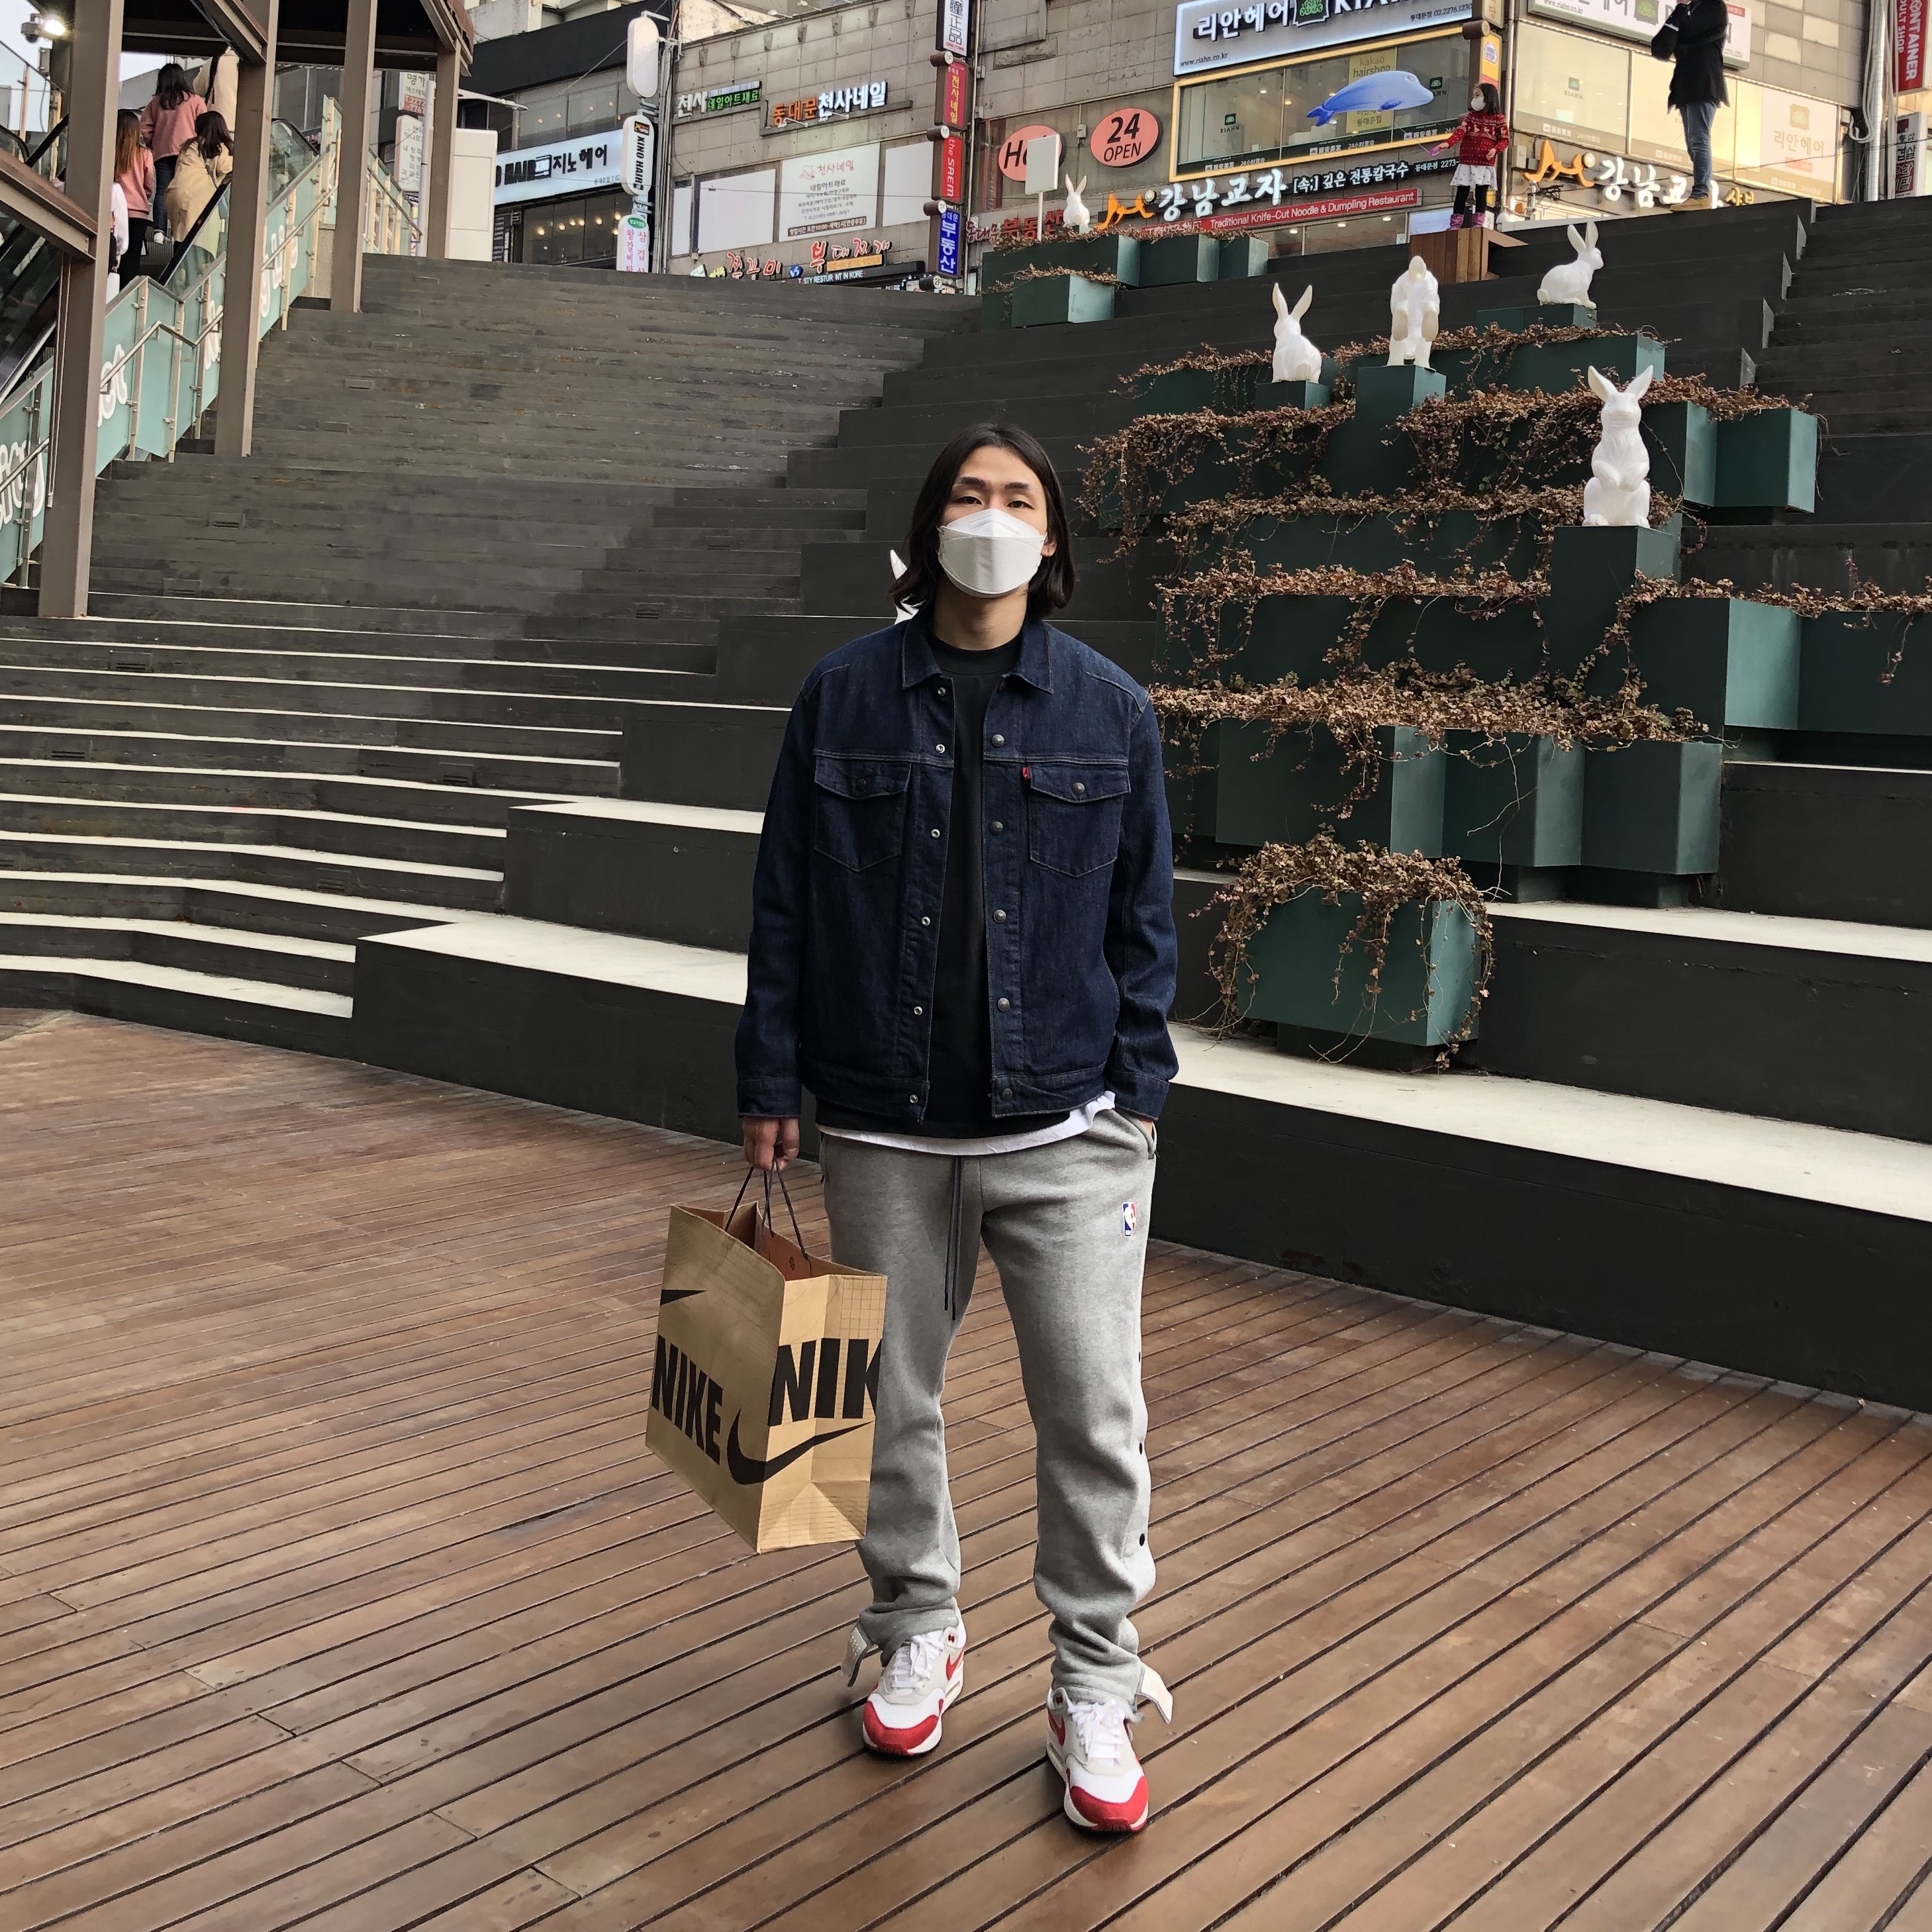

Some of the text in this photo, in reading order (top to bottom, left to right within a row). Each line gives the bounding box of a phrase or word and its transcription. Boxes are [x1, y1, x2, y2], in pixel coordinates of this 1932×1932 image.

[1196, 1, 1290, 42] 리안헤어
[1359, 56, 1385, 67] kakao
[407, 73, 426, 88] 명가
[677, 90, 760, 118] 천사 네일아트재료
[771, 80, 888, 126] 동대문 천사네일
[949, 74, 960, 124] 천사네일
[1106, 113, 1140, 145] 24
[1220, 124, 1240, 134] RIAHN
[1357, 115, 1382, 127] 동대문점
[1103, 141, 1142, 163] OPEN
[1772, 129, 1825, 157] 리안헤어
[636, 160, 644, 184] HAIR
[817, 159, 855, 176] 천사네일
[946, 138, 956, 197] the SAEM
[810, 179, 846, 192] 네일아트재료
[1159, 169, 1288, 222] 강남교자
[1322, 171, 1345, 191] 깊은
[1349, 162, 1410, 186] 전통칼국수
[1210, 213, 1250, 229] Traditional
[1251, 208, 1290, 224] Knife-Cut
[1290, 203, 1320, 219] Noodle
[1320, 203, 1327, 214] &
[1328, 198, 1367, 216] Dumpling
[1368, 191, 1415, 207] Restaurant
[940, 219, 957, 275] 부동산
[843, 271, 849, 280] IN
[652, 1333, 723, 1466] NIKE
